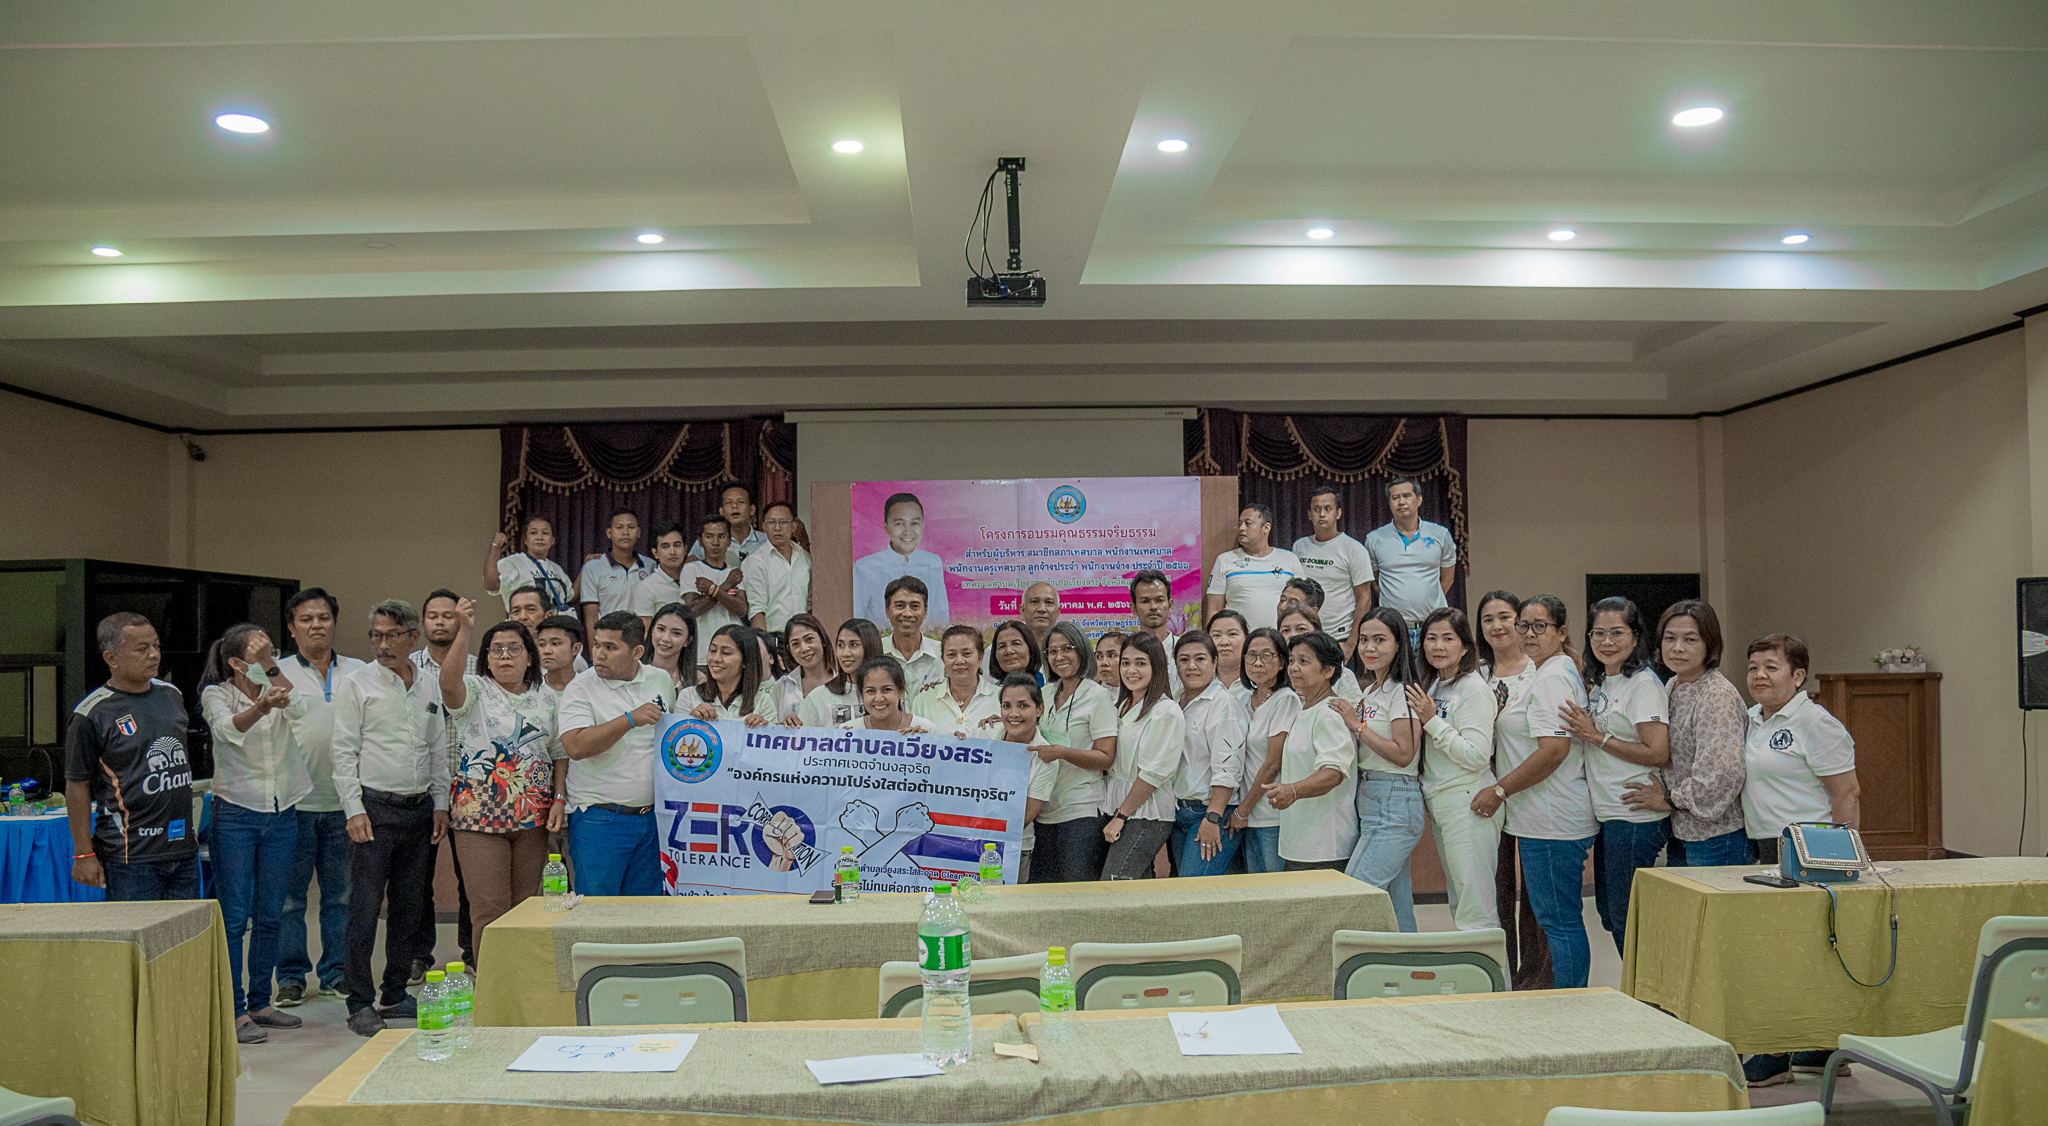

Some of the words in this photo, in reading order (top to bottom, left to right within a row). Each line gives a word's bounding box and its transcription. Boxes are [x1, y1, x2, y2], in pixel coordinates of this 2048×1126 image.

[979, 525, 1157, 543] โครงการอบรมคุณธรรมจริยธรรม
[965, 547, 1025, 561] สำหรับผู้บริหาร
[1027, 546, 1103, 557] สมาชิกสภาเทศบาล
[1105, 546, 1172, 556] พนักงานเทศบาล
[949, 562, 1026, 575] พนักงานครูเทศบาล
[1028, 560, 1079, 575] ลูกจ้างประจำ
[1081, 560, 1130, 570] พนักงานจ้าง
[1132, 560, 1164, 570] ประจำปี
[1165, 561, 1189, 570] ๒๕๖๖
[962, 578, 1041, 588] เทศบาลตำบลเวียงส
[998, 598, 1017, 610] วันที่
[1060, 601, 1085, 609] หาคม
[1086, 601, 1106, 609] พ.ศ.
[746, 731, 993, 764] เทศบาลตำบลเวียงสระ
[803, 755, 931, 776] ประกาศเจตจำนงสุจริต
[138, 827, 164, 837] true
[664, 800, 816, 873] ZERO
[668, 848, 751, 869] TOLERANCE
[941, 870, 963, 880] Clean
